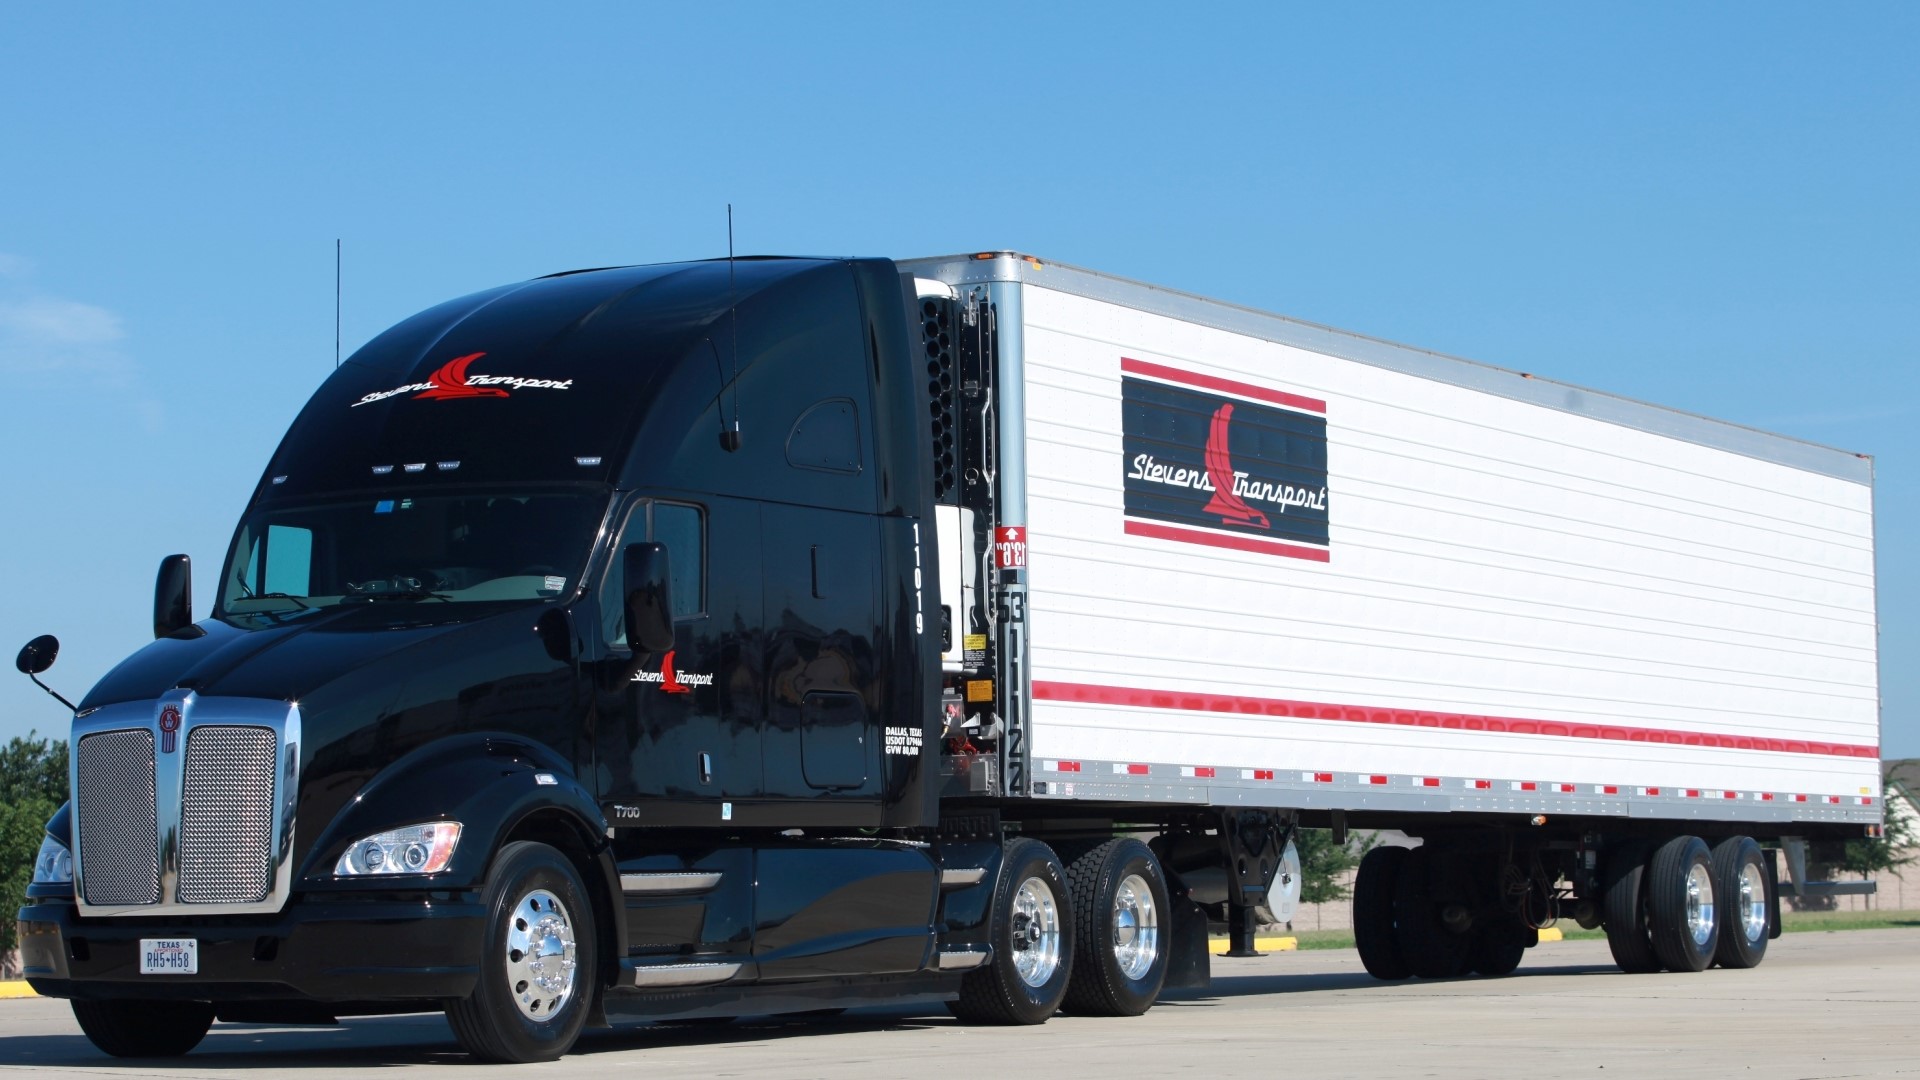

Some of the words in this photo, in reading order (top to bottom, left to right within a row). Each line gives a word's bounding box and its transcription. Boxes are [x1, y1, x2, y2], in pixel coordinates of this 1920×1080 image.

[351, 381, 439, 407] Stevens
[464, 375, 573, 389] Transport
[1128, 454, 1216, 491] Stevens
[1232, 471, 1326, 513] Transport
[913, 523, 923, 634] 11019
[675, 669, 713, 688] Transport
[885, 726, 908, 737] DALLAS,
[909, 727, 923, 737] TEXAS
[885, 736, 905, 746] USDOT
[885, 745, 901, 755] GVW
[614, 805, 640, 818] T700
[157, 941, 180, 949] TEXAS
